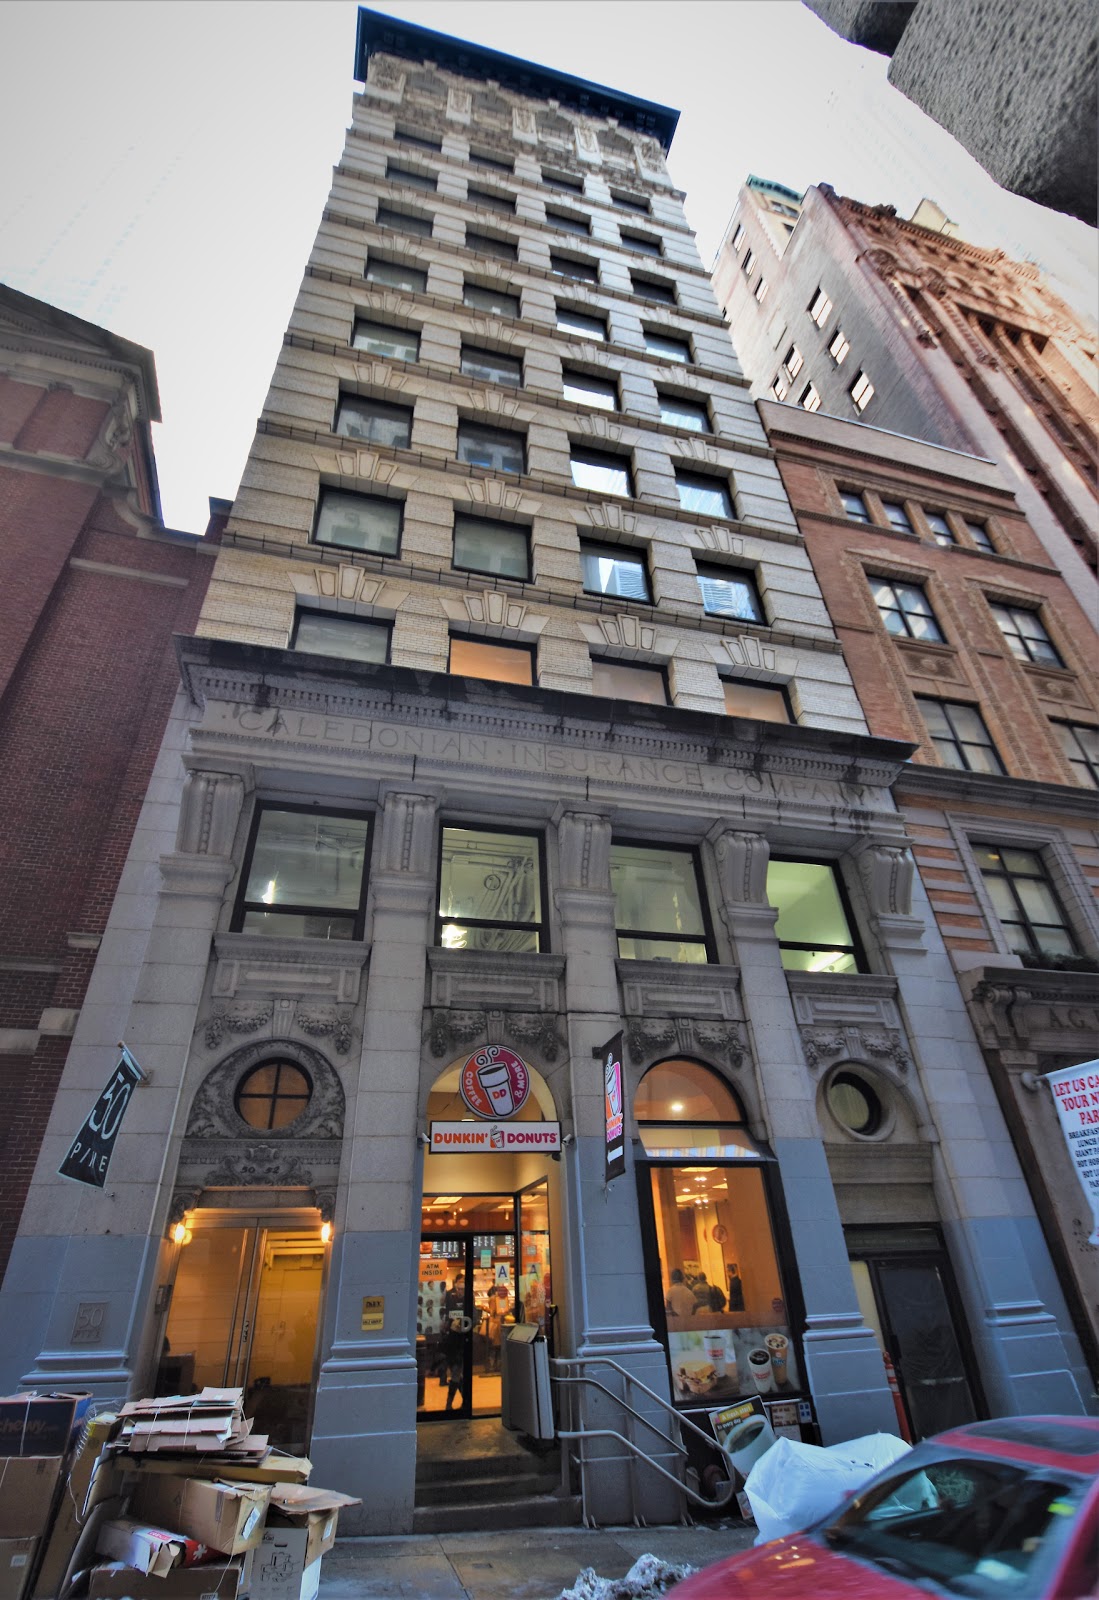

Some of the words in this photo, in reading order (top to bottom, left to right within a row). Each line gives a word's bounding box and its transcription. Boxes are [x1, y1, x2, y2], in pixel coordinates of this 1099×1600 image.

[238, 708, 488, 760] CALEDONIAN
[511, 744, 704, 787] INSURANCE
[723, 771, 866, 806] COMPANY
[511, 1060, 525, 1089] MORE
[466, 1071, 482, 1106] COFFEE
[492, 1088, 507, 1100] DD
[1053, 1081, 1071, 1097] LET
[1072, 1078, 1086, 1092] US
[88, 1072, 131, 1140] 50
[1061, 1094, 1090, 1111] YOUR
[433, 1132, 489, 1144] DUNKIN'
[507, 1132, 558, 1144] DONUTS
[1077, 1137, 1097, 1147] LUNCH
[70, 1142, 108, 1172] PINE
[1075, 1148, 1093, 1157] GIANT
[498, 1265, 507, 1278] A
